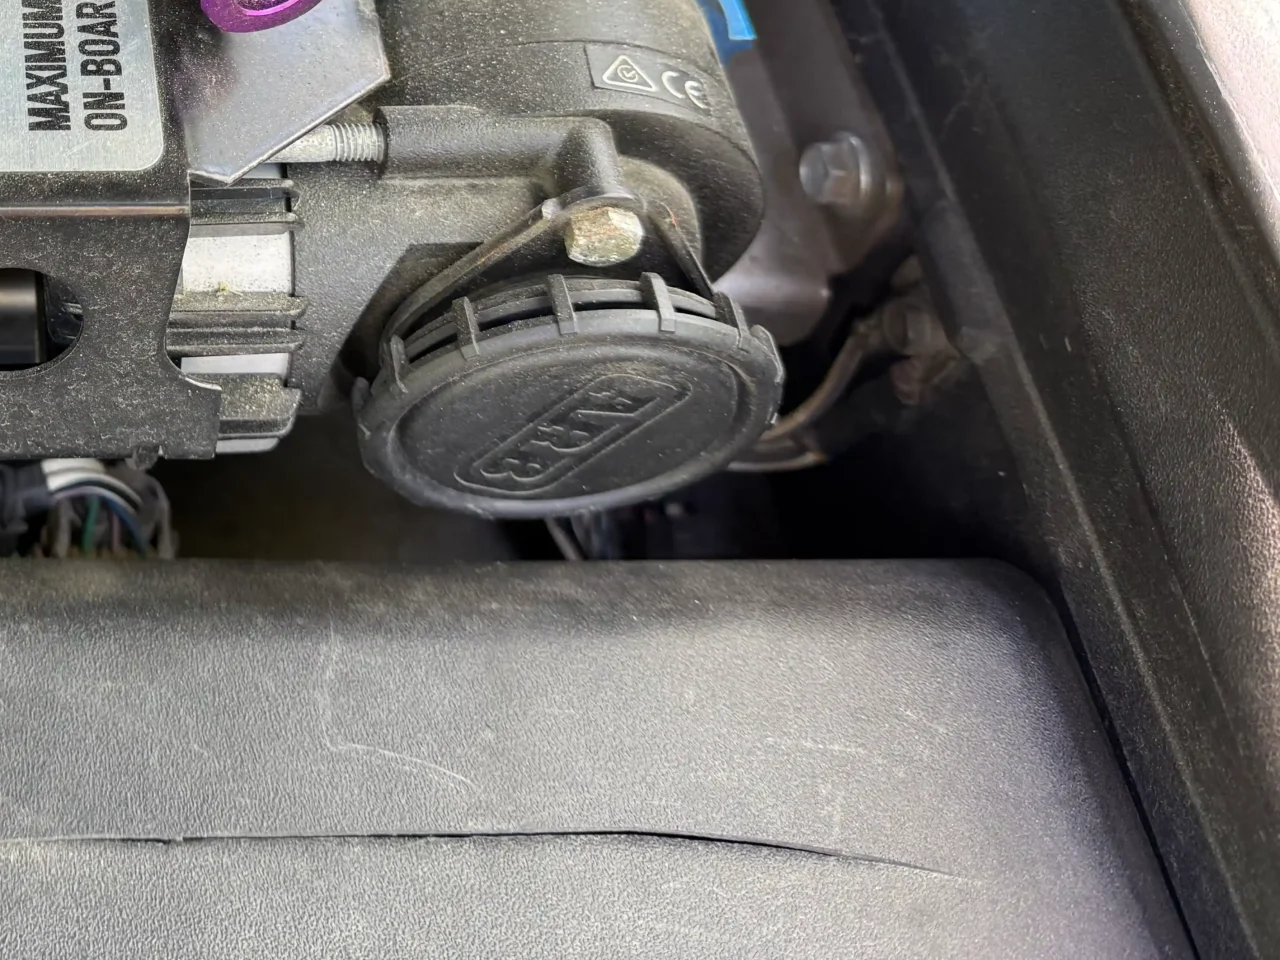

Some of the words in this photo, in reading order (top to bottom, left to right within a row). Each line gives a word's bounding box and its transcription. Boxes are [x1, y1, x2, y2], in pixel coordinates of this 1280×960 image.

[22, 0, 71, 132] MAXIMUM
[661, 70, 711, 110] CE
[479, 388, 662, 484] ARB
